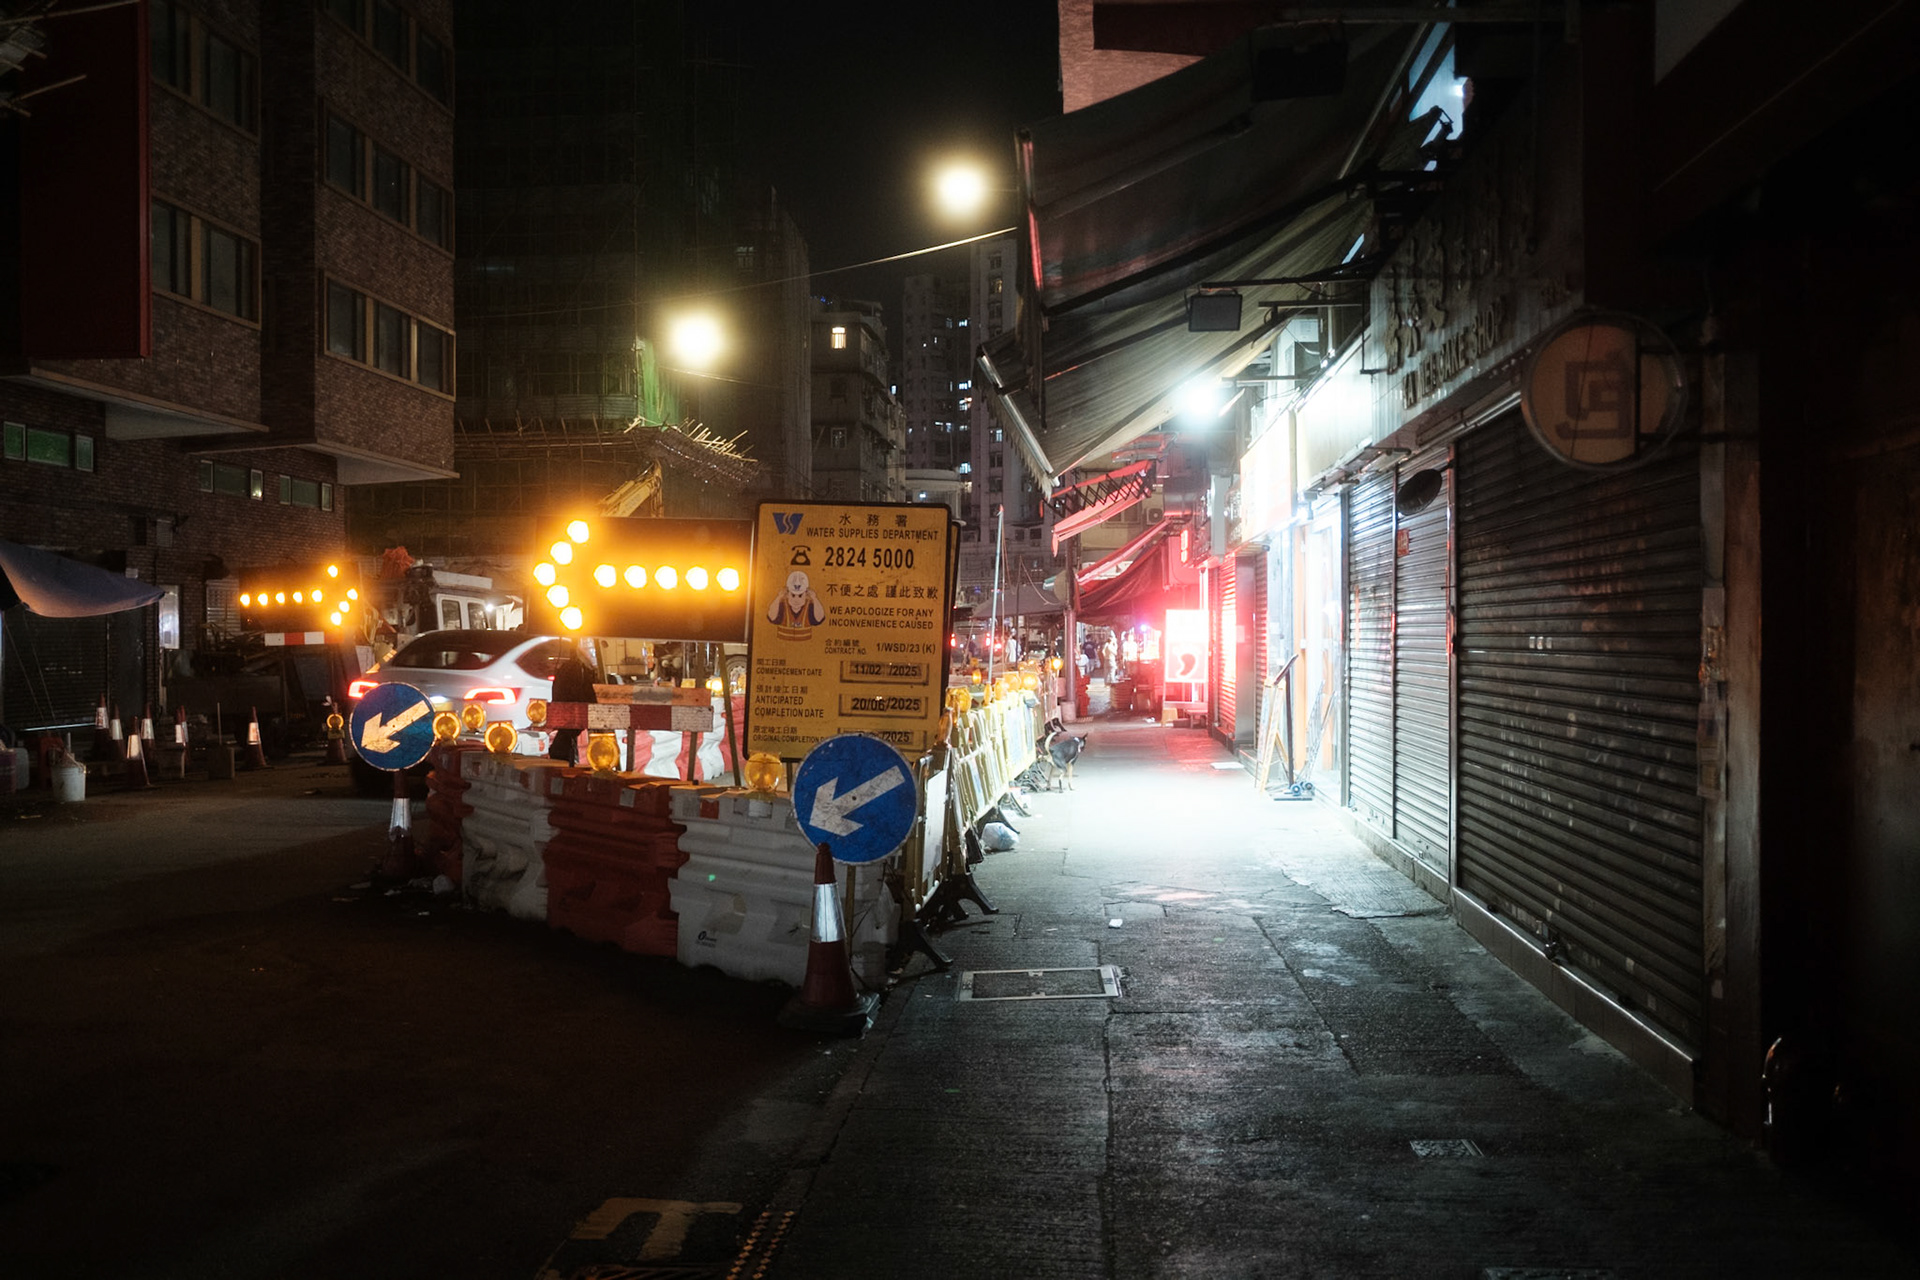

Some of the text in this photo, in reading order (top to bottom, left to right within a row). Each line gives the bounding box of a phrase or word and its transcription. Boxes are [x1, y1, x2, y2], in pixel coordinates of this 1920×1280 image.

[839, 514, 908, 527] 水務署
[806, 527, 939, 541] WATER SUPPLIES DEPARTMENT
[825, 546, 914, 569] 2824 5000
[826, 583, 938, 600] 不便之處 謹此致歉
[829, 606, 935, 618] WE APOLOGIZE FOR ANY
[829, 619, 934, 630] INCONVENIENCE CAUSED
[824, 647, 856, 655] CONTRACT
[876, 642, 936, 655] 1/WSD/23 (K)
[756, 667, 822, 677] COMMENCEMENT DATE
[854, 664, 882, 675] 11/02
[755, 695, 804, 705] ANTICIPATED
[754, 707, 824, 718] COMPLETION DATE
[753, 734, 781, 742] ORIGINAL
[782, 735, 820, 743] COMPLETION
